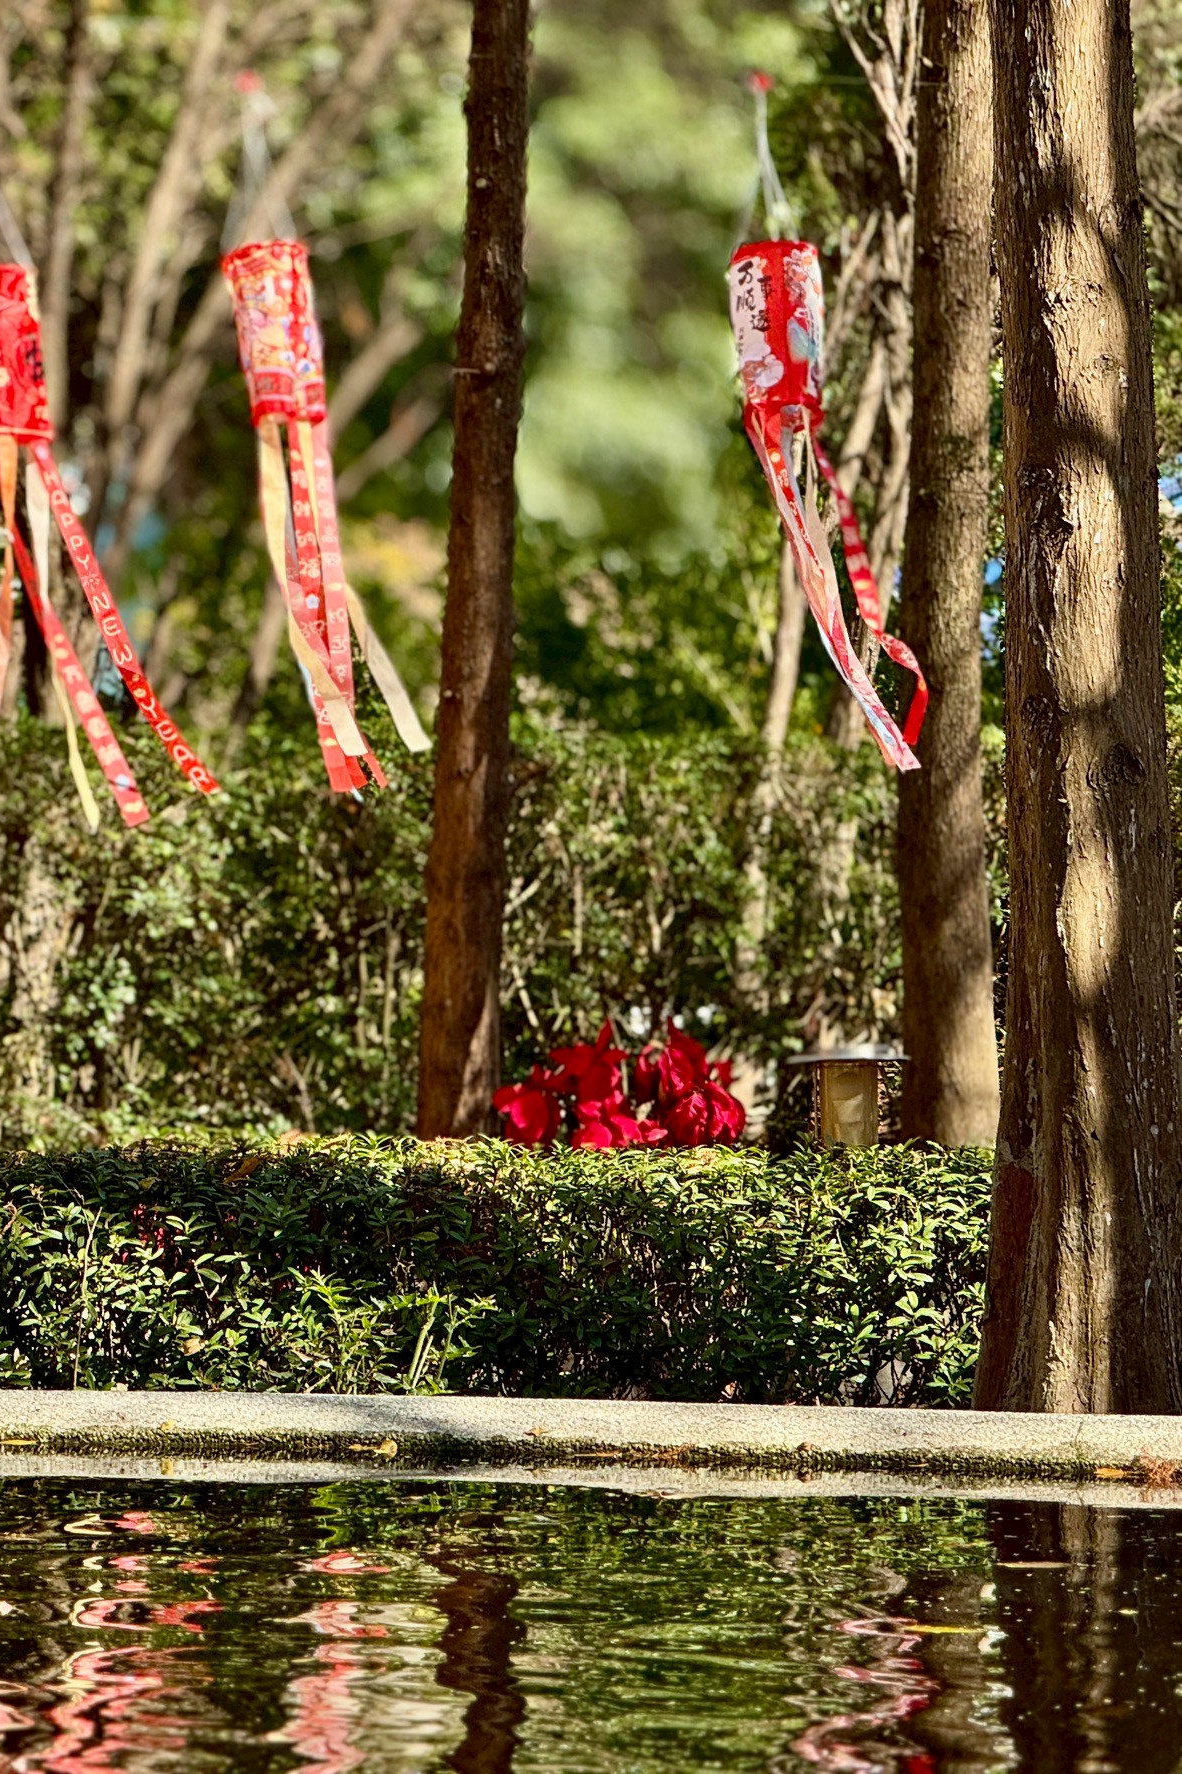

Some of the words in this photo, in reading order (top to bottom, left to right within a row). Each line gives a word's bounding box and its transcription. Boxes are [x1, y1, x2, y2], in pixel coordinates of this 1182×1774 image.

[43, 471, 89, 570] HAPPY
[92, 593, 132, 665] NEW
[140, 698, 210, 788] YEAR
